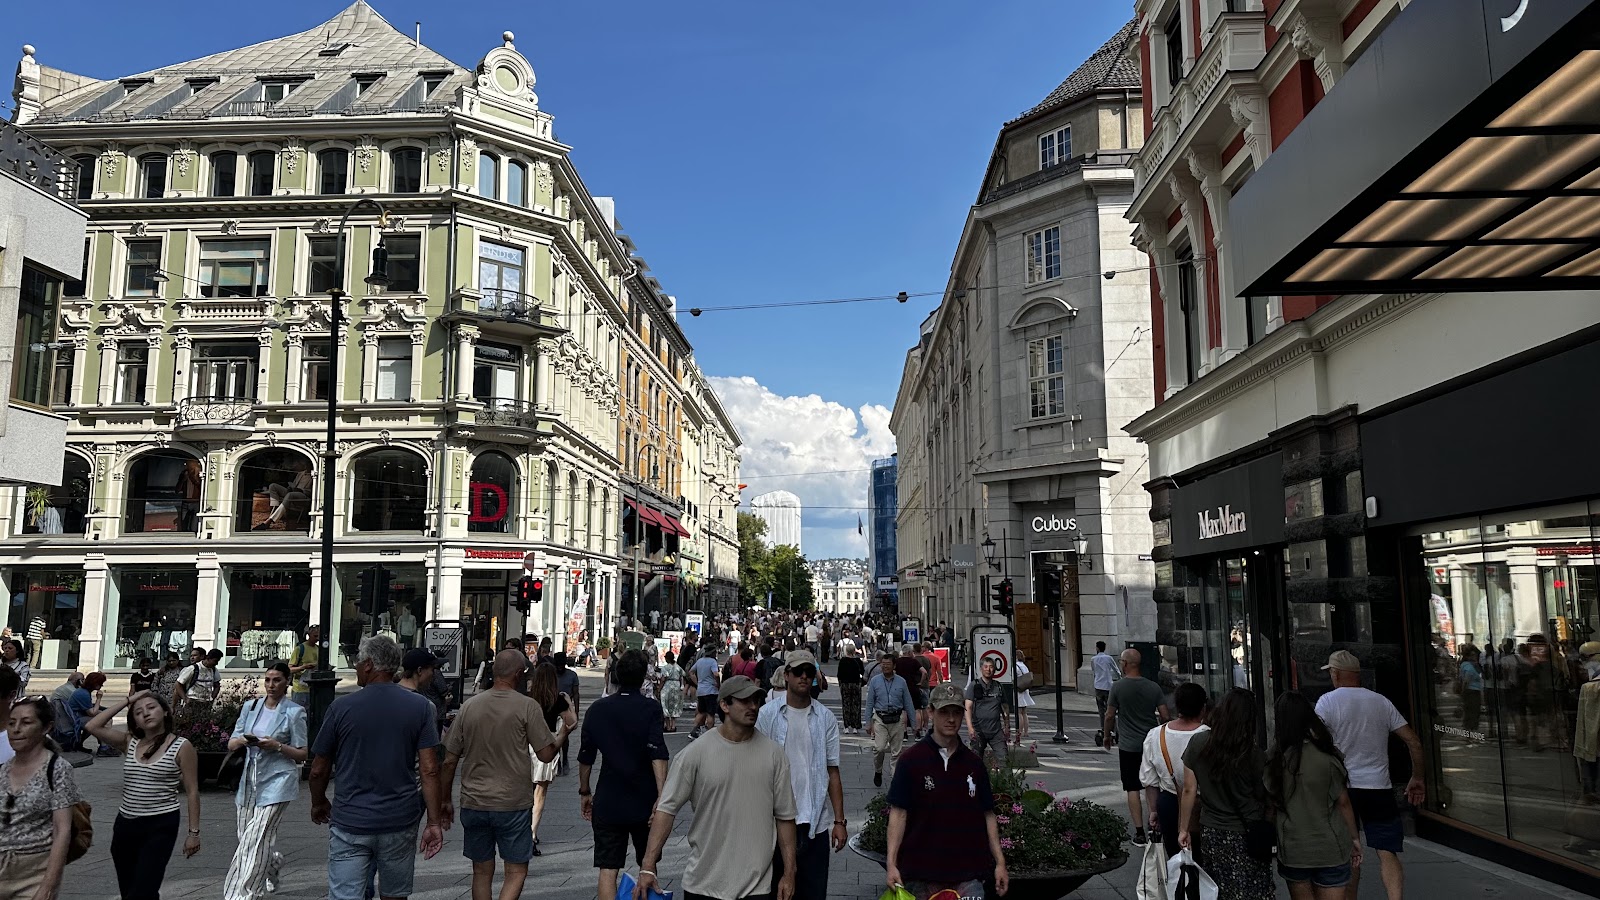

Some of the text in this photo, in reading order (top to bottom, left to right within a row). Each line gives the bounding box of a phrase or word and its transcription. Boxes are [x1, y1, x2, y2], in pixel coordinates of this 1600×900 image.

[468, 482, 509, 523] D
[1032, 514, 1077, 532] Cubus
[1198, 504, 1246, 540] MaxMara
[465, 548, 524, 559] Dressmann
[980, 636, 1005, 645] Sone
[1434, 723, 1485, 741] SALE CONTINUES INSIDE
